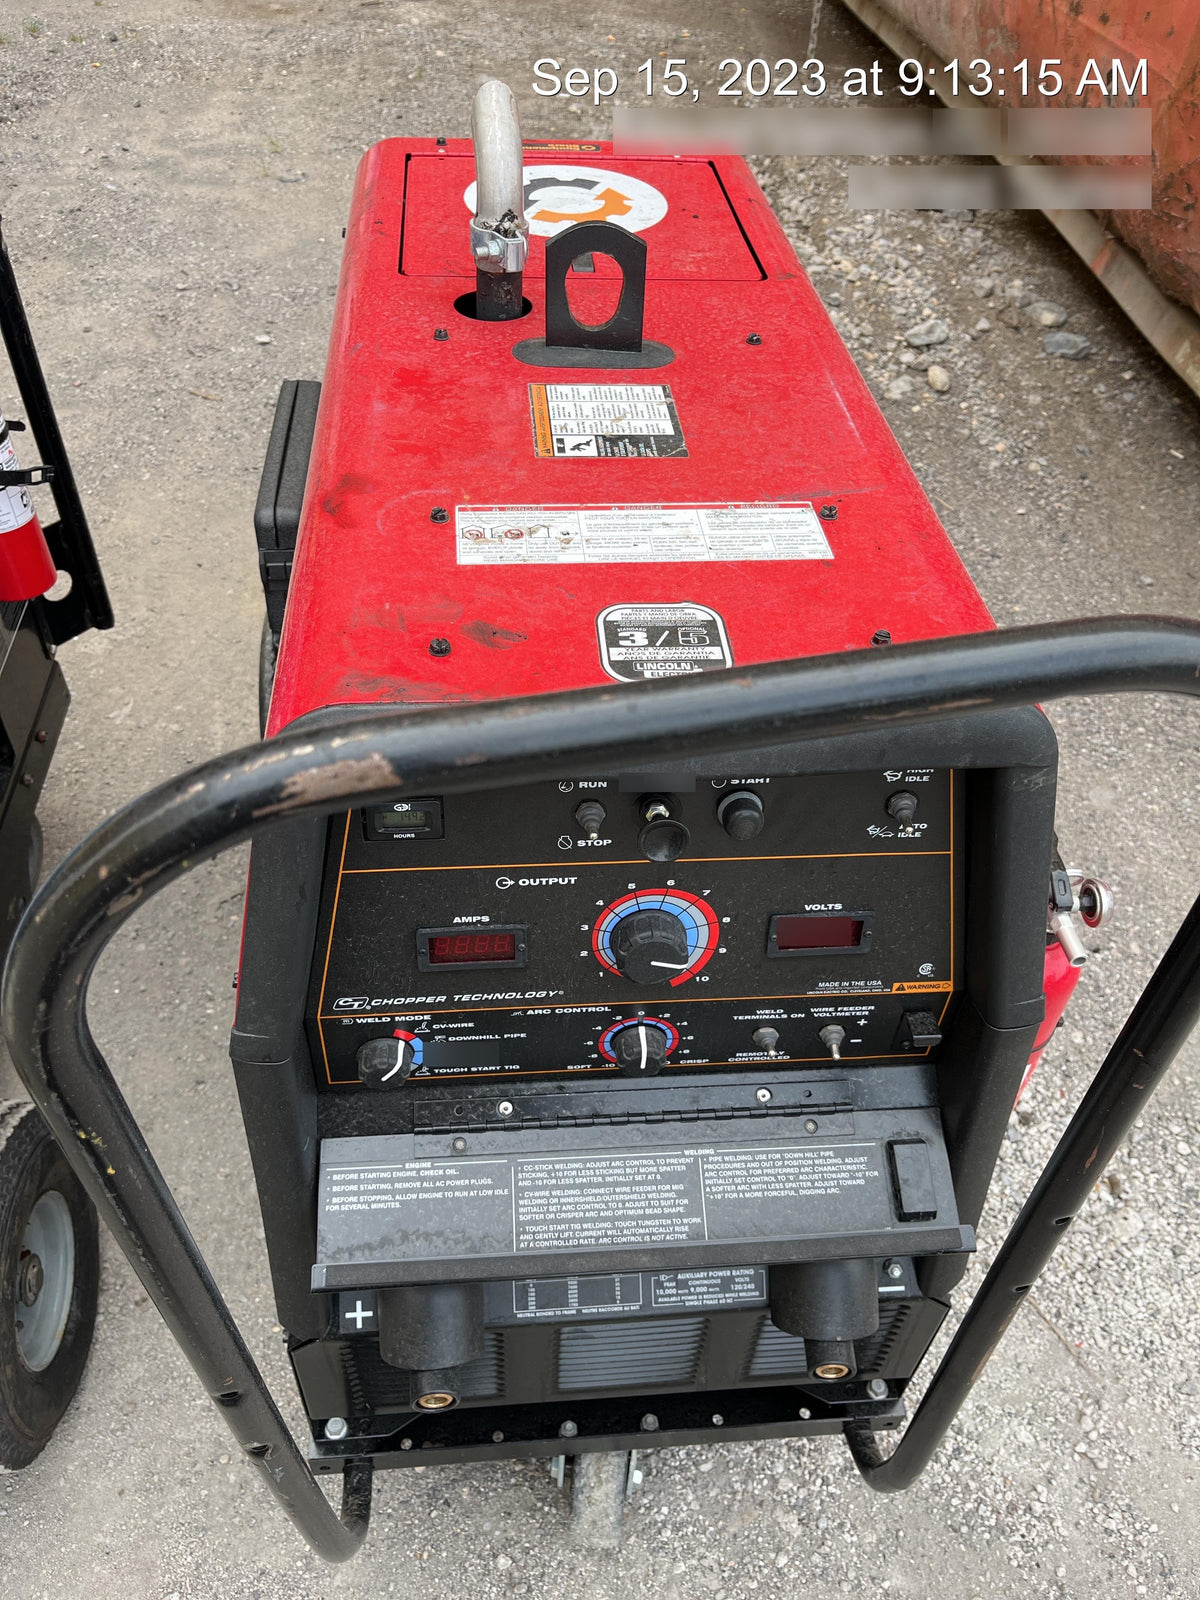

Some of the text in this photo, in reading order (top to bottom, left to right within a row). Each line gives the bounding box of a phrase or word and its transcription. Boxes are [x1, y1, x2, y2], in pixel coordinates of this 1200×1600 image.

[618, 632, 648, 646] 3
[678, 630, 709, 646] 5
[577, 839, 612, 847] STOP
[519, 877, 577, 886] OUTPUT
[371, 995, 447, 1006] CHOPPER
[524, 1163, 553, 1171] CC-STICK
[554, 1162, 585, 1170] WELDING:
[332, 1172, 358, 1180] BEFORE
[360, 1171, 391, 1179] STARTING
